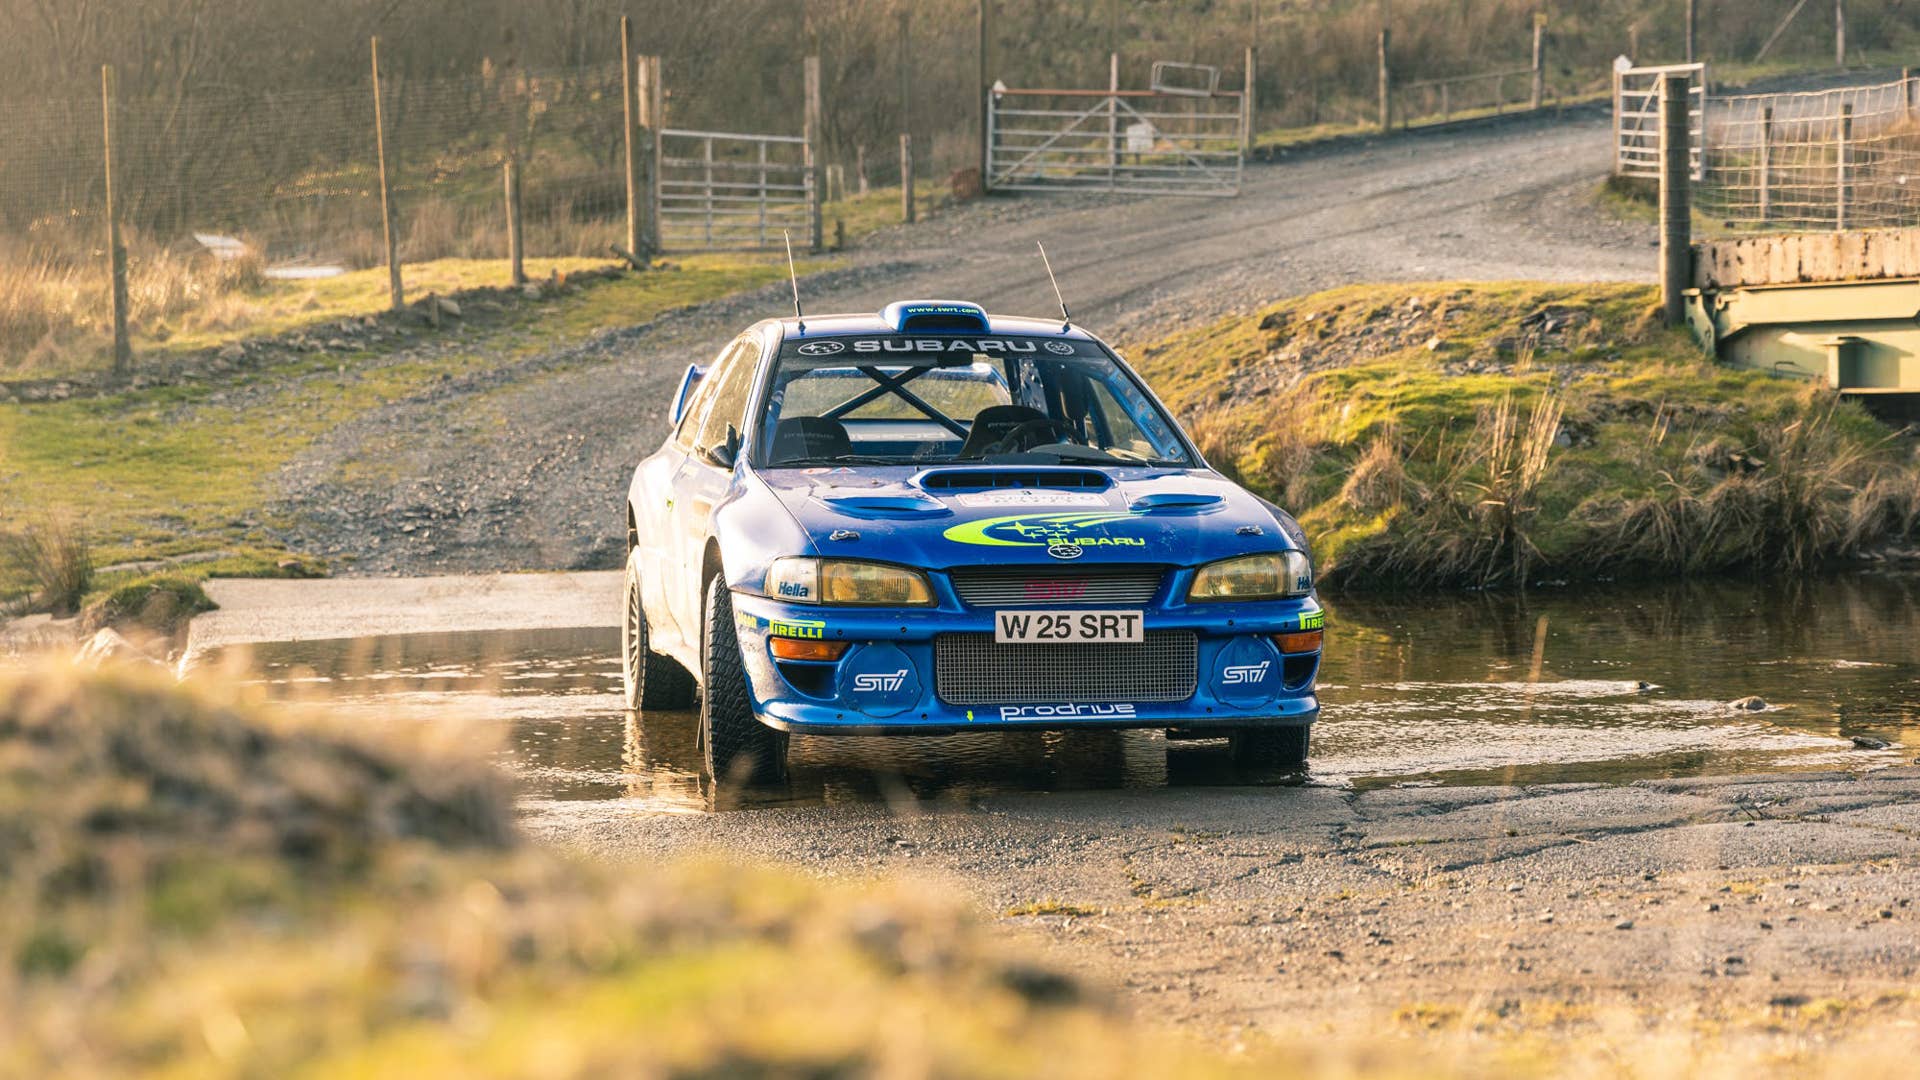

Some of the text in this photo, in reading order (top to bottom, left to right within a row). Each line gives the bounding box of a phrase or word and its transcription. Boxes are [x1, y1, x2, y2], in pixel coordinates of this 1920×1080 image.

[853, 340, 1037, 352] SUBARU
[1047, 537, 1146, 546] SUBARU
[778, 581, 809, 598] Hella
[769, 619, 826, 639] PIRELLI
[1001, 614, 1139, 639] W 25 SRT
[999, 703, 1137, 722] prodrive
